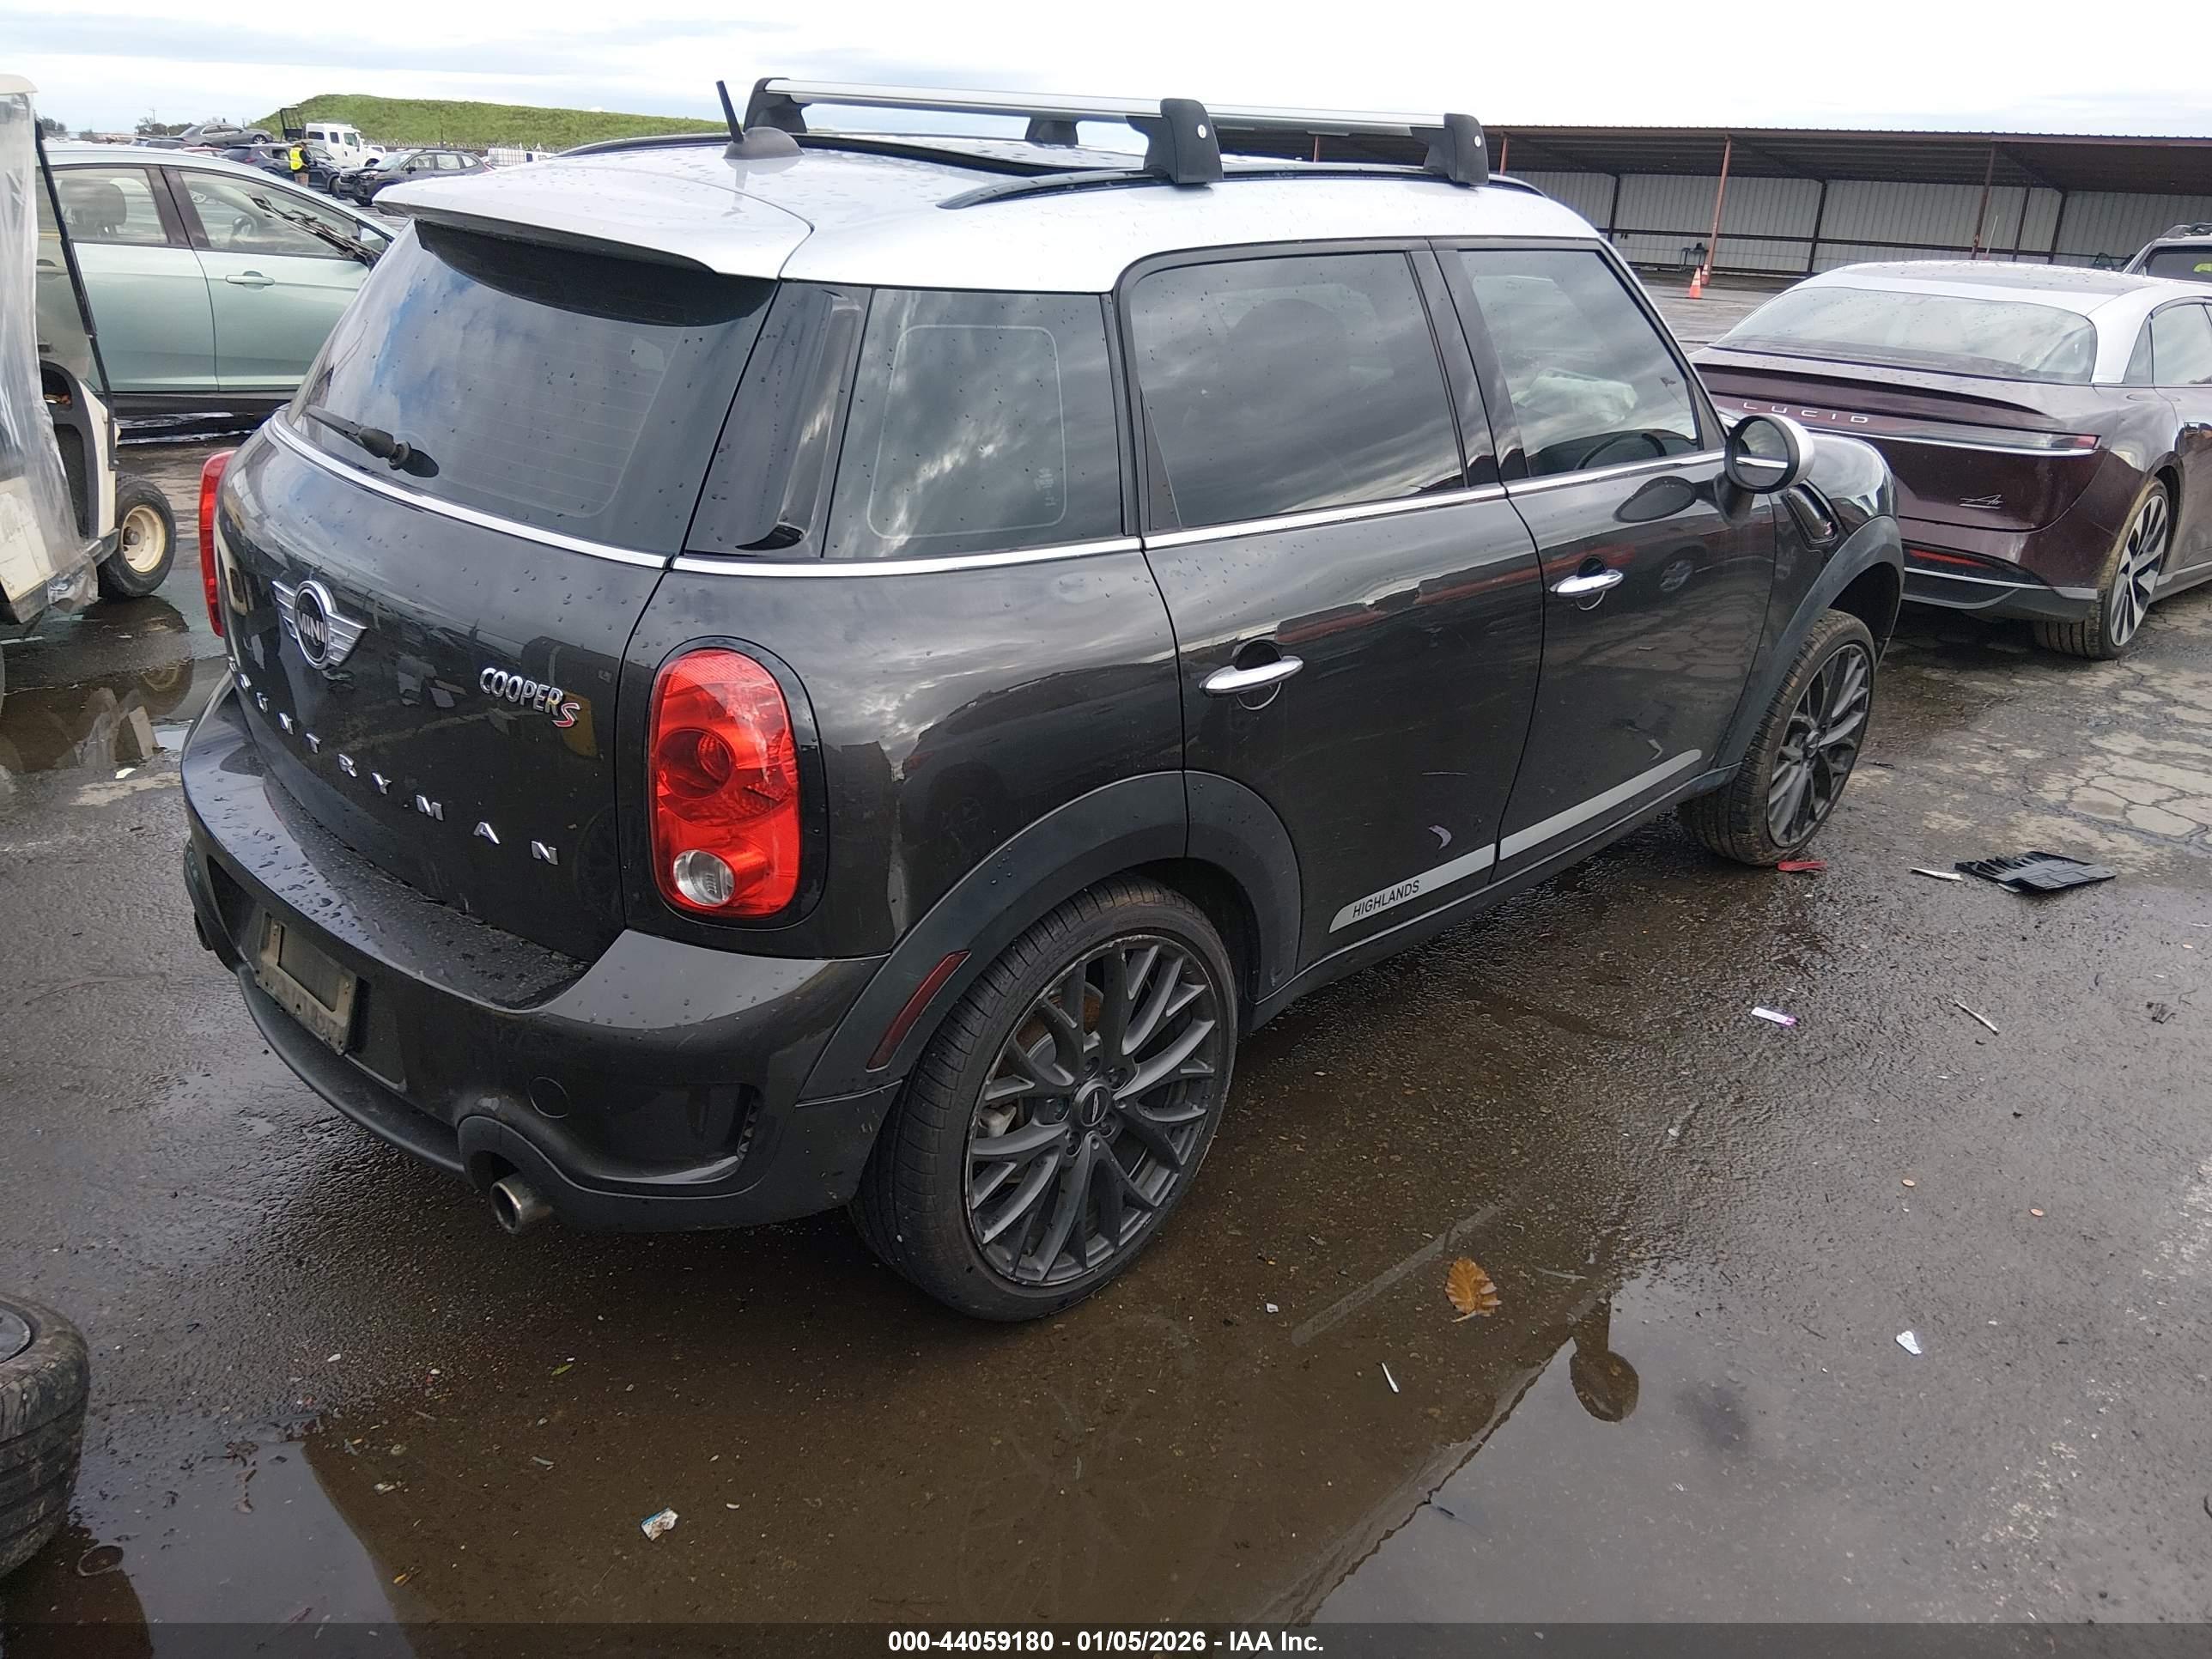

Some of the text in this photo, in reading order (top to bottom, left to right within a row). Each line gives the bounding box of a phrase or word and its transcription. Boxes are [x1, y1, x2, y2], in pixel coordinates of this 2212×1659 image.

[1742, 401, 1869, 424] LUCID
[295, 608, 326, 644] MINI
[479, 667, 581, 728] COOPER S
[1352, 879, 1420, 919] HIGHLANDS
